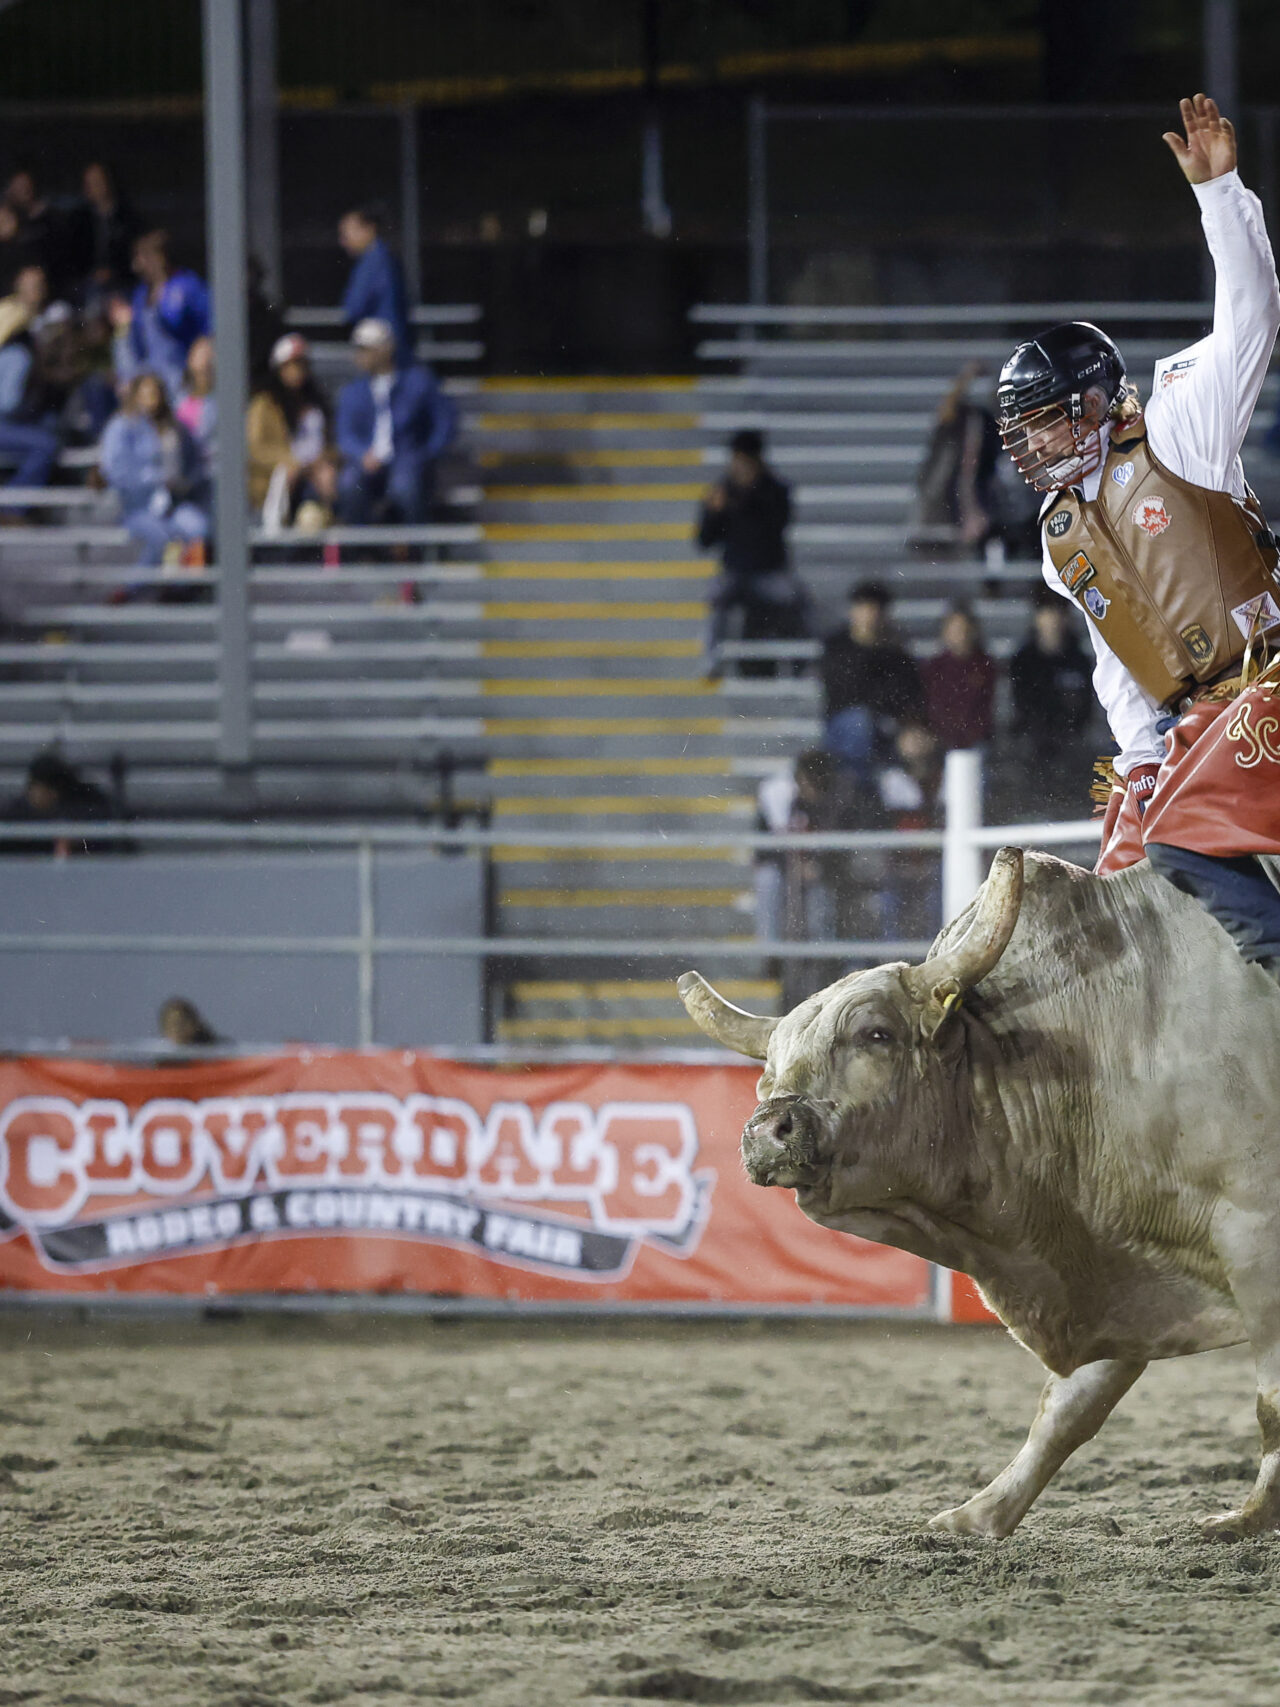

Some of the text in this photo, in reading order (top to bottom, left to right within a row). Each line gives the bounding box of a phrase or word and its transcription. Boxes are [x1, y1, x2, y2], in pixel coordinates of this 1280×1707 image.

[0, 1094, 697, 1234] CLOVERDALE
[107, 1192, 583, 1267] RODEO & COUNTRY FAIR
